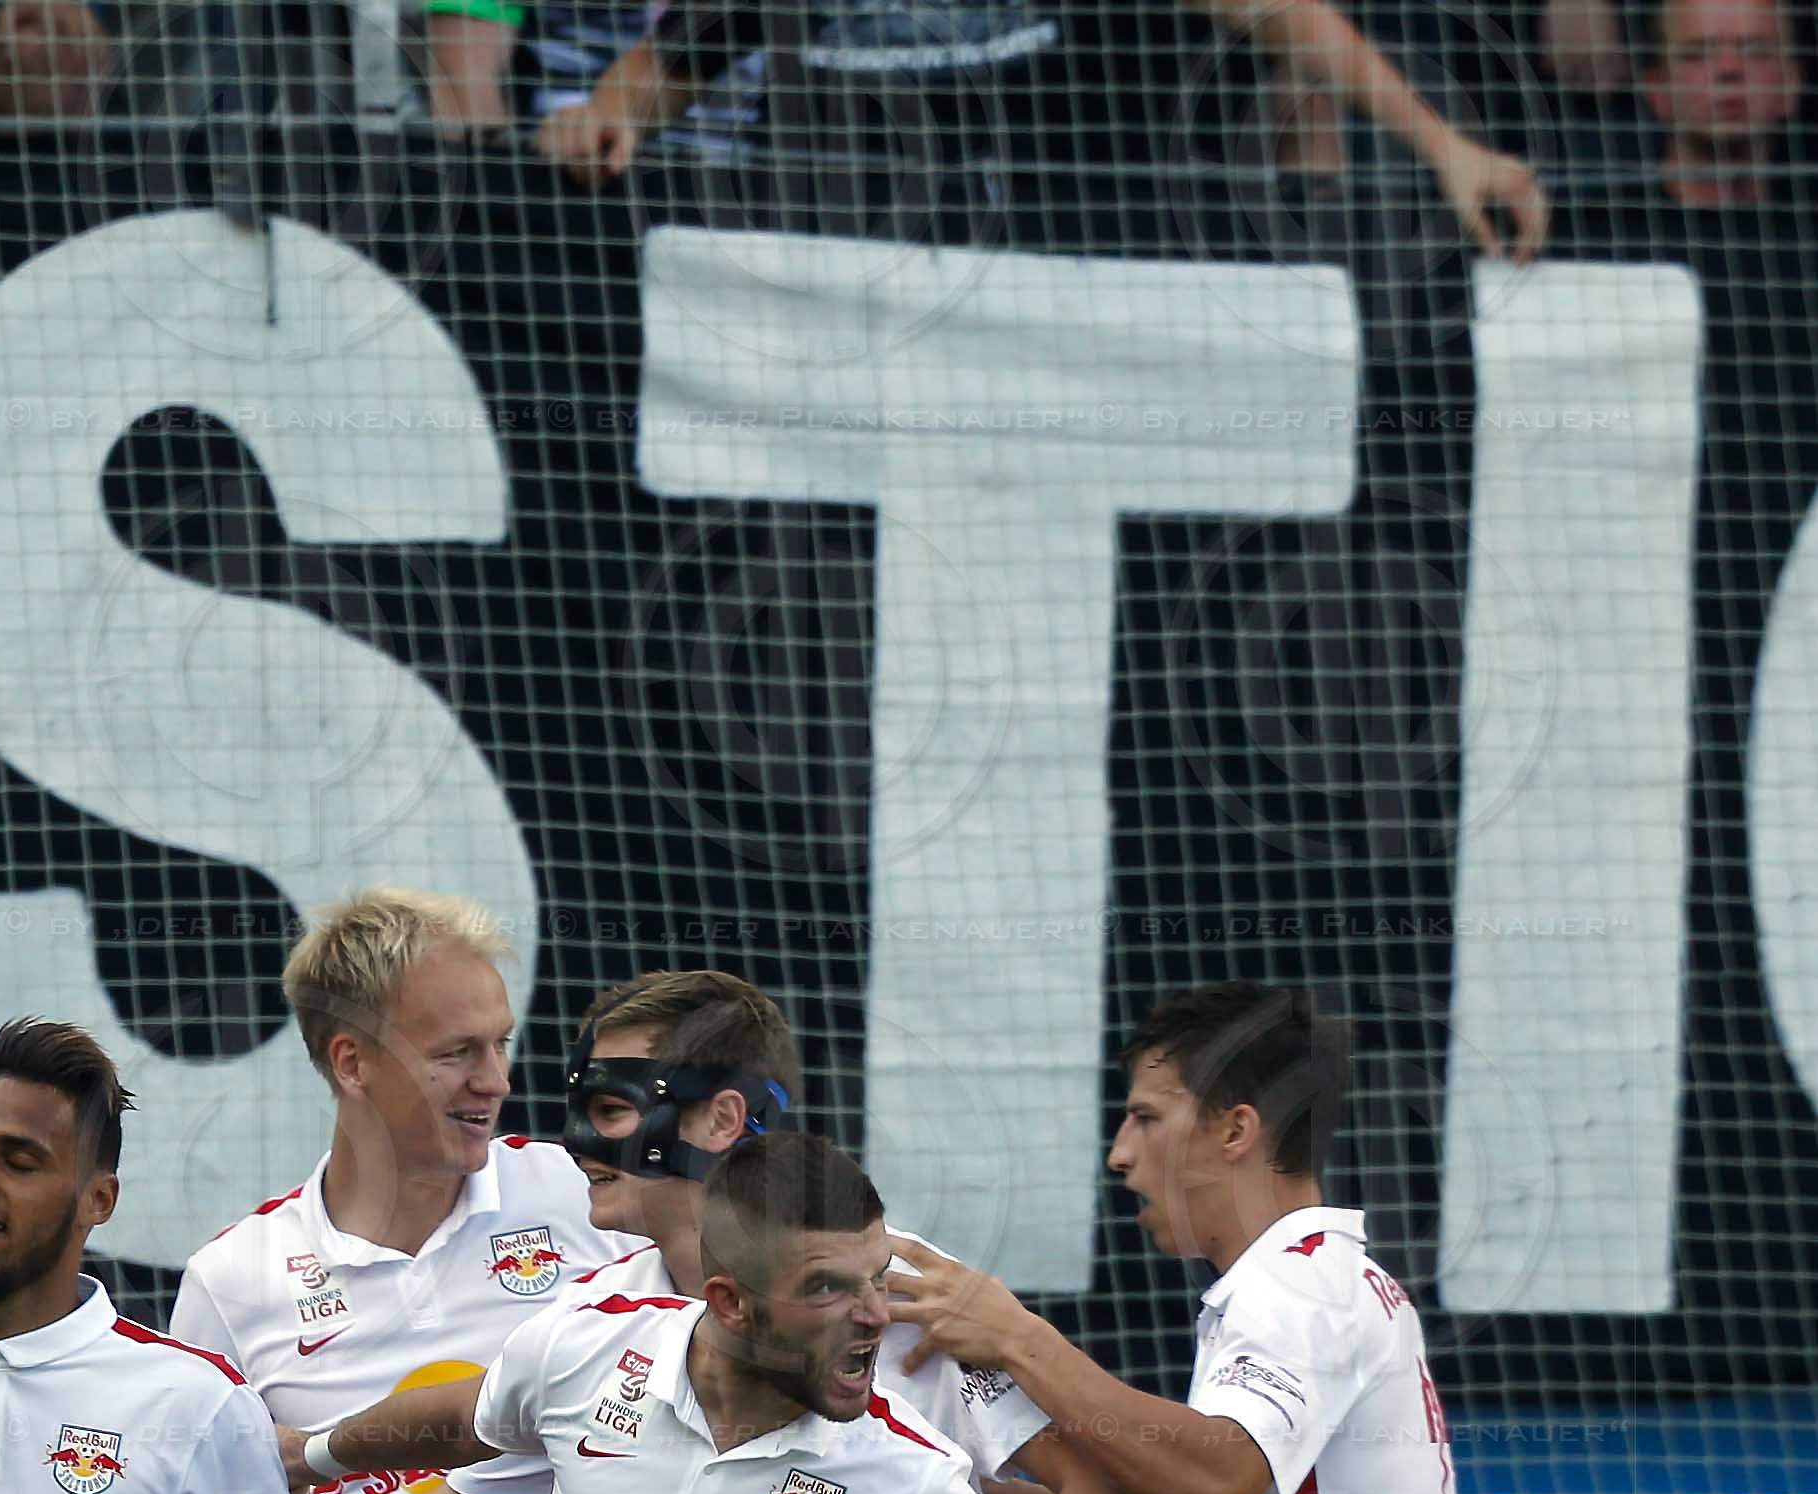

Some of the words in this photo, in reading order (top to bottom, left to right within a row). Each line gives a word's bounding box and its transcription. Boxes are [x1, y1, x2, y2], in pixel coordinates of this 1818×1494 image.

[300, 1298, 349, 1323] LIGA
[594, 1406, 638, 1438] LIGA
[601, 1397, 644, 1423] BUNDES
